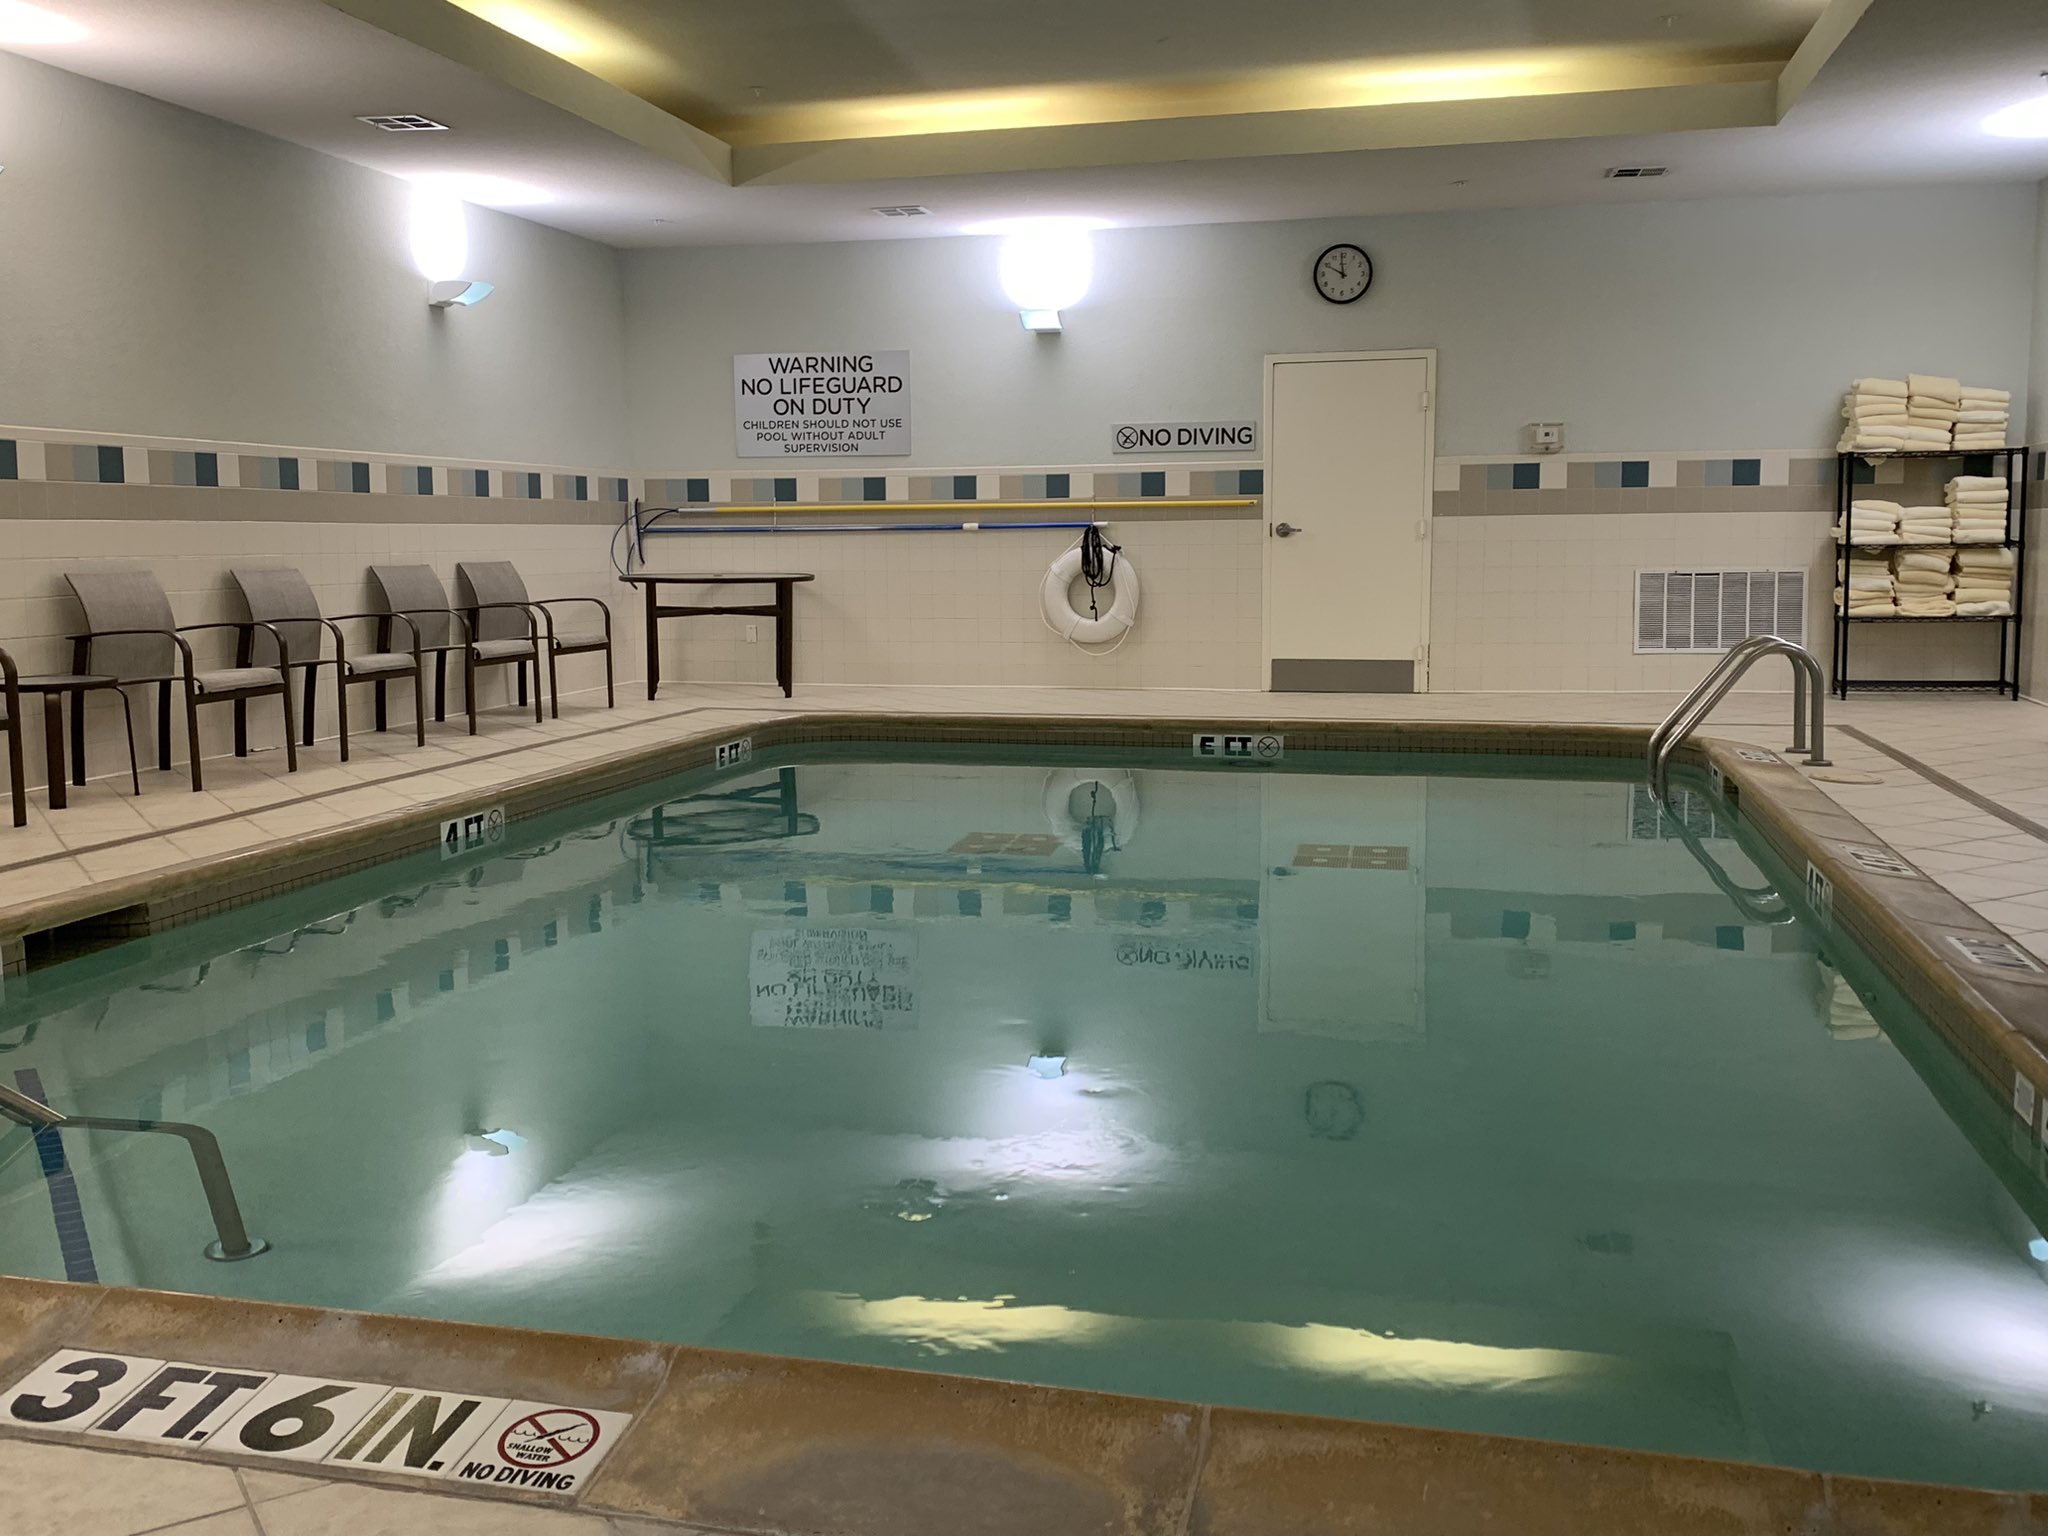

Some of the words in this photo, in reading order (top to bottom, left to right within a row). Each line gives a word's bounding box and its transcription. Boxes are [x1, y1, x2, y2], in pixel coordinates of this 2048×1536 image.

[769, 355, 873, 374] WARNING
[742, 378, 772, 395] NO
[780, 376, 903, 395] LIFEGUARD
[773, 398, 804, 415] ON
[813, 397, 871, 415] DUTY
[743, 420, 799, 430] CHILDREN
[803, 419, 849, 429] SHOULD
[853, 419, 877, 428] NOT
[880, 418, 902, 428] USE
[757, 432, 787, 441] POOL
[791, 431, 845, 441] WITHOUT
[848, 431, 886, 440] ADULT
[1139, 428, 1171, 447] NO
[1178, 427, 1253, 446] DIVING
[784, 443, 859, 453] SUPERVISION
[10, 1357, 128, 1423] 3
[96, 1364, 268, 1441] FT.
[240, 1385, 342, 1452] 6
[334, 1392, 481, 1471] IN.
[506, 1442, 554, 1454] SHALLOW
[515, 1451, 550, 1462] WATER
[458, 1462, 494, 1480] NO
[493, 1467, 575, 1490] DIVING
